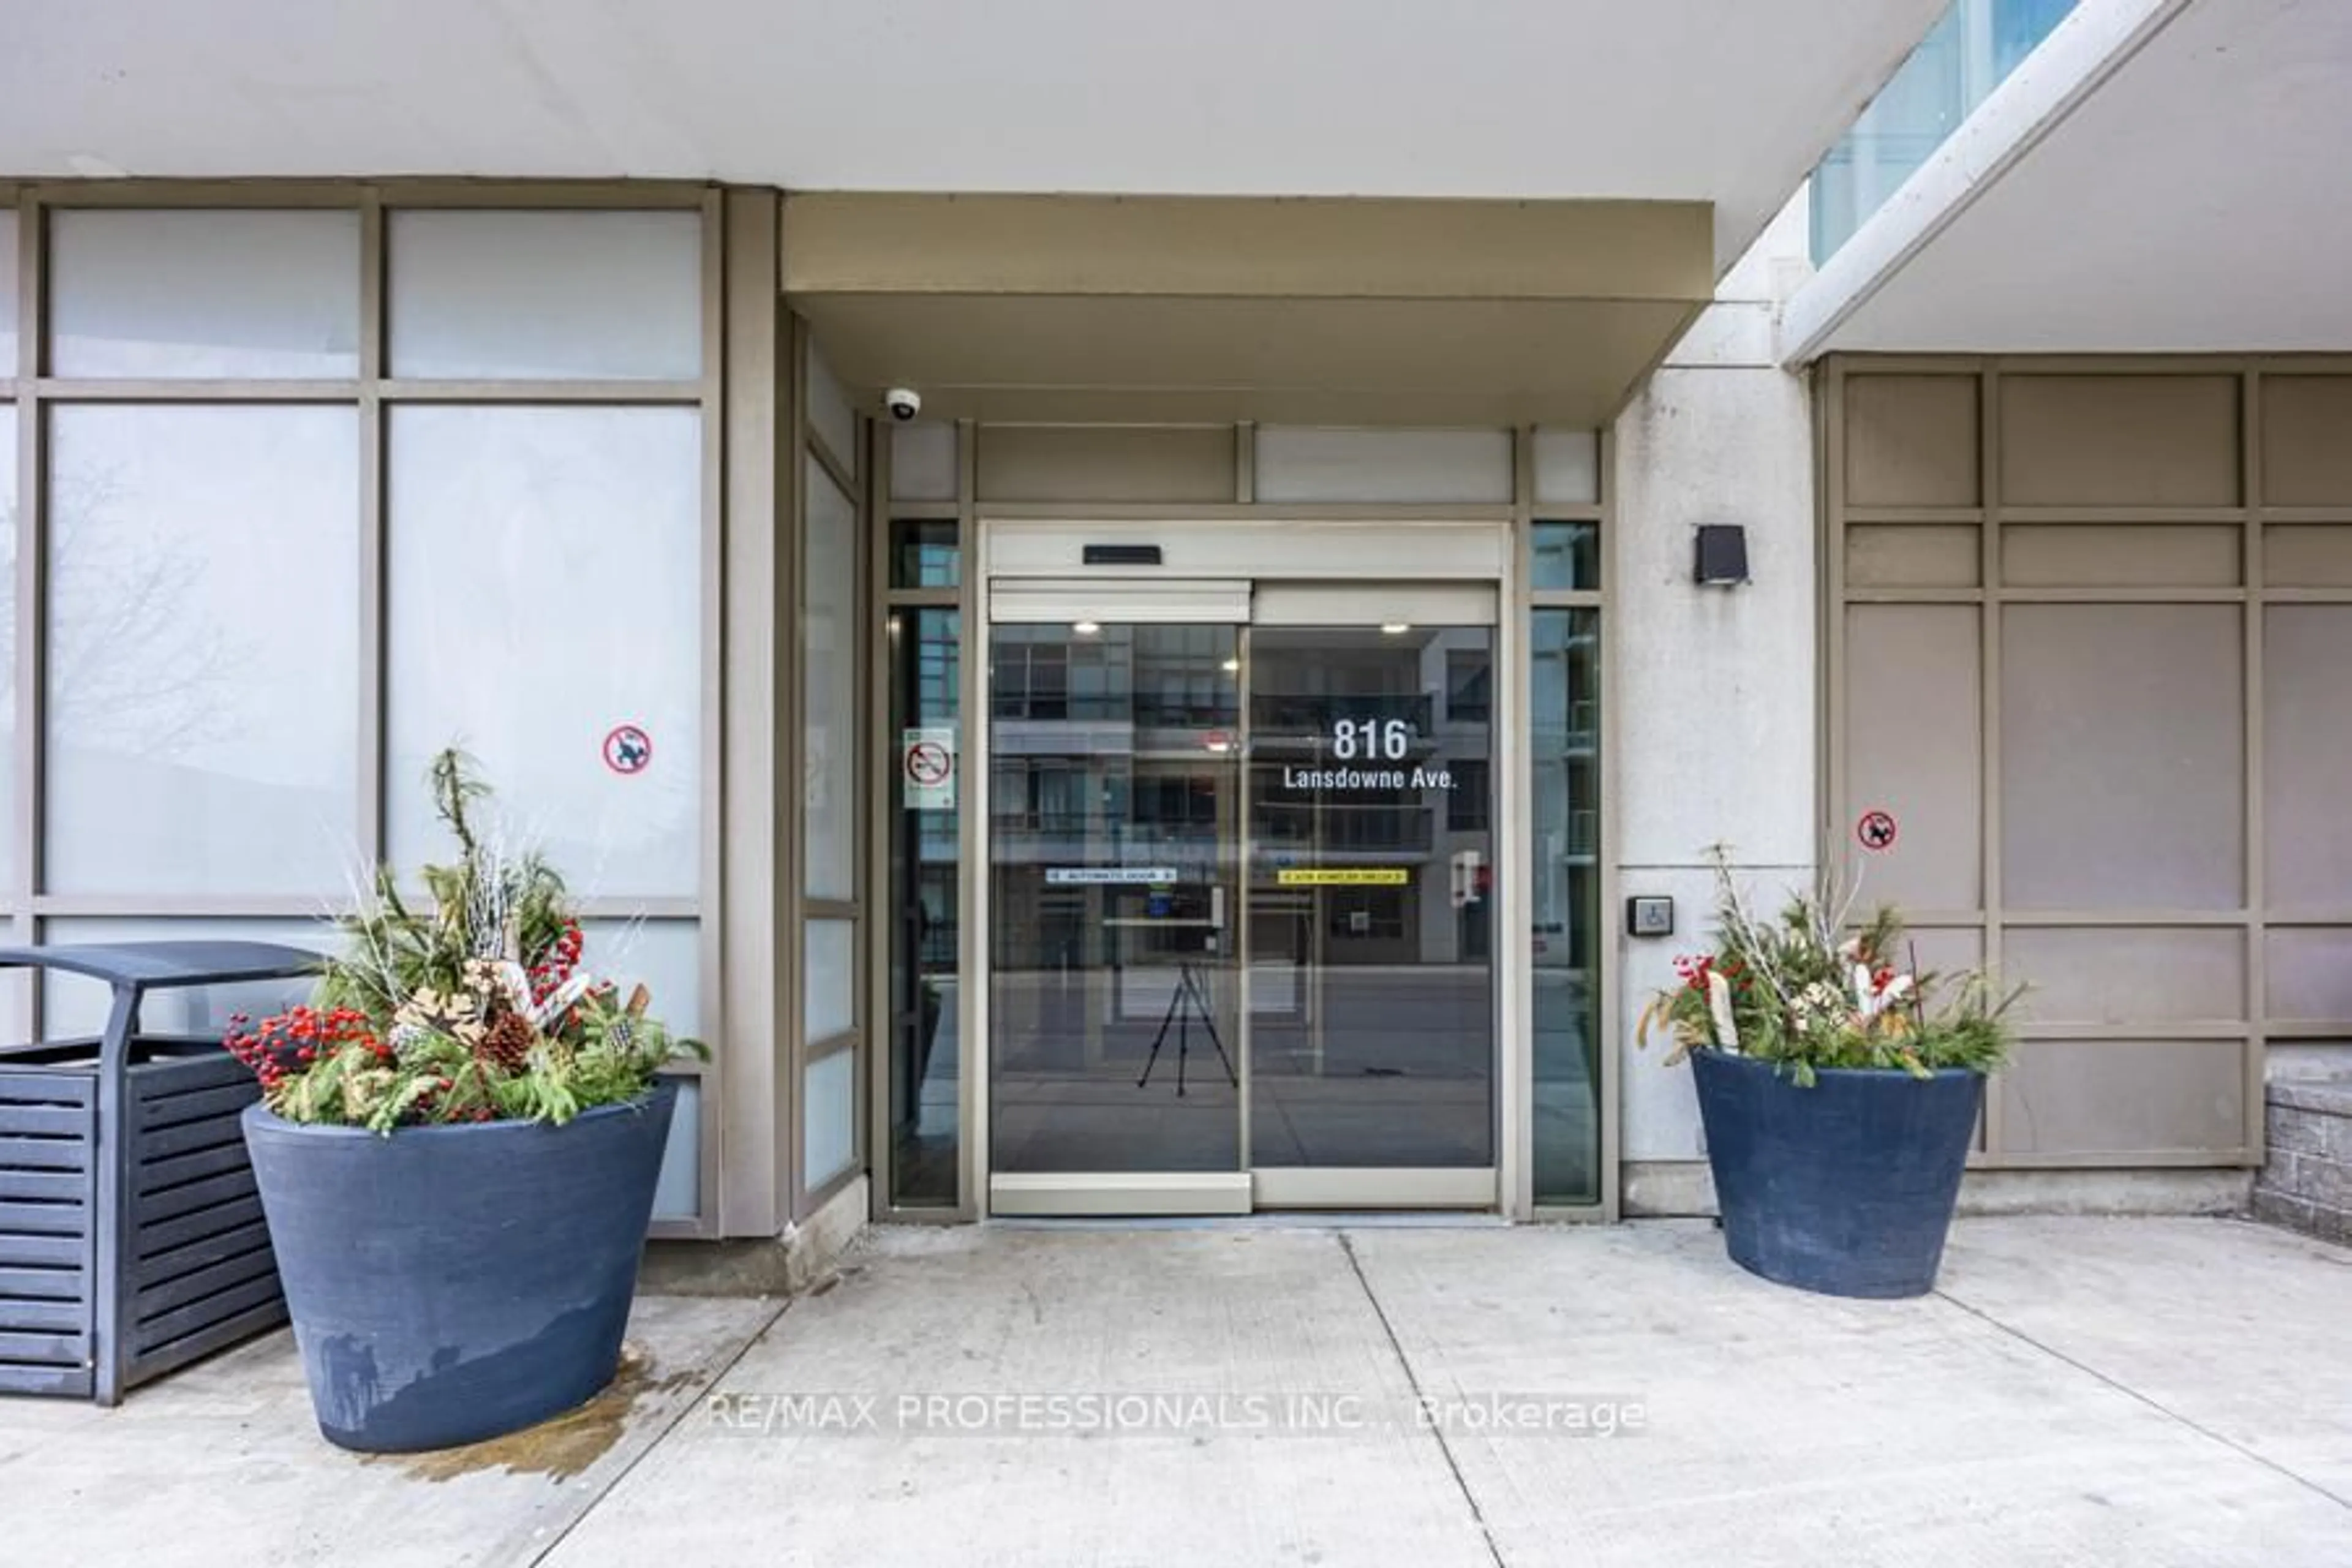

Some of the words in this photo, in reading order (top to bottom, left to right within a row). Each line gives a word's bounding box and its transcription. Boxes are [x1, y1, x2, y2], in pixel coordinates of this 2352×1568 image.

[1333, 718, 1408, 760] 816
[1284, 766, 1405, 789] Lansdowne
[1411, 766, 1458, 789] Ave.
